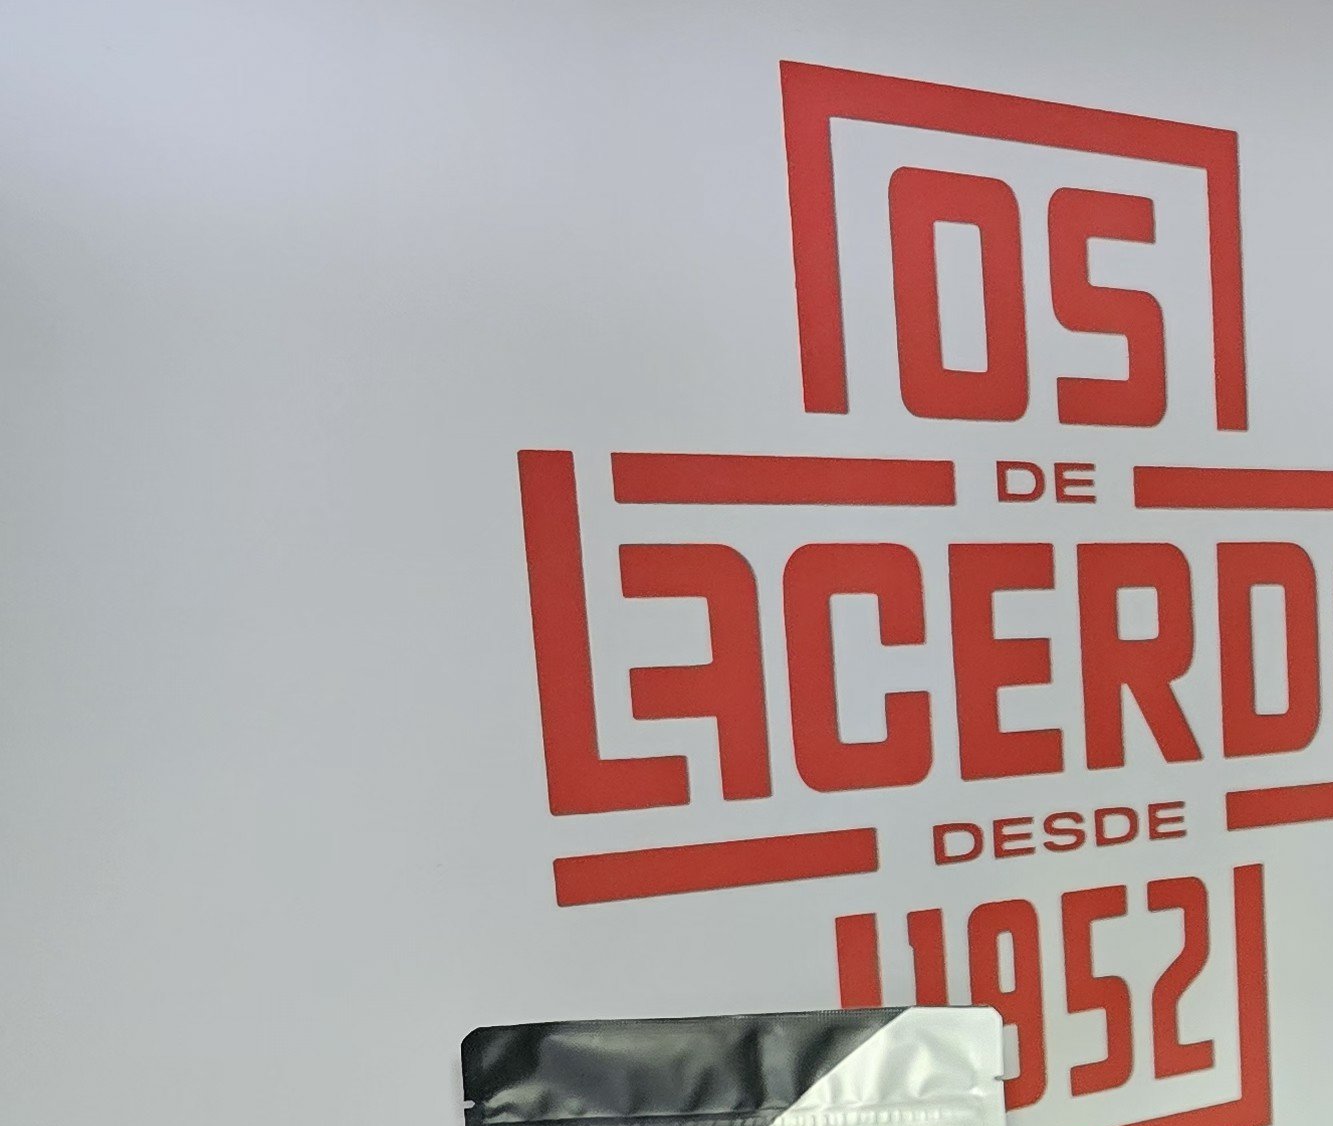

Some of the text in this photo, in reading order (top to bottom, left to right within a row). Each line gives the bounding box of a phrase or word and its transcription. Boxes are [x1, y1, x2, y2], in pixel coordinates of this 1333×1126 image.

[888, 165, 1167, 428] OS
[995, 459, 1096, 503] DE
[932, 802, 1188, 866] DESDE
